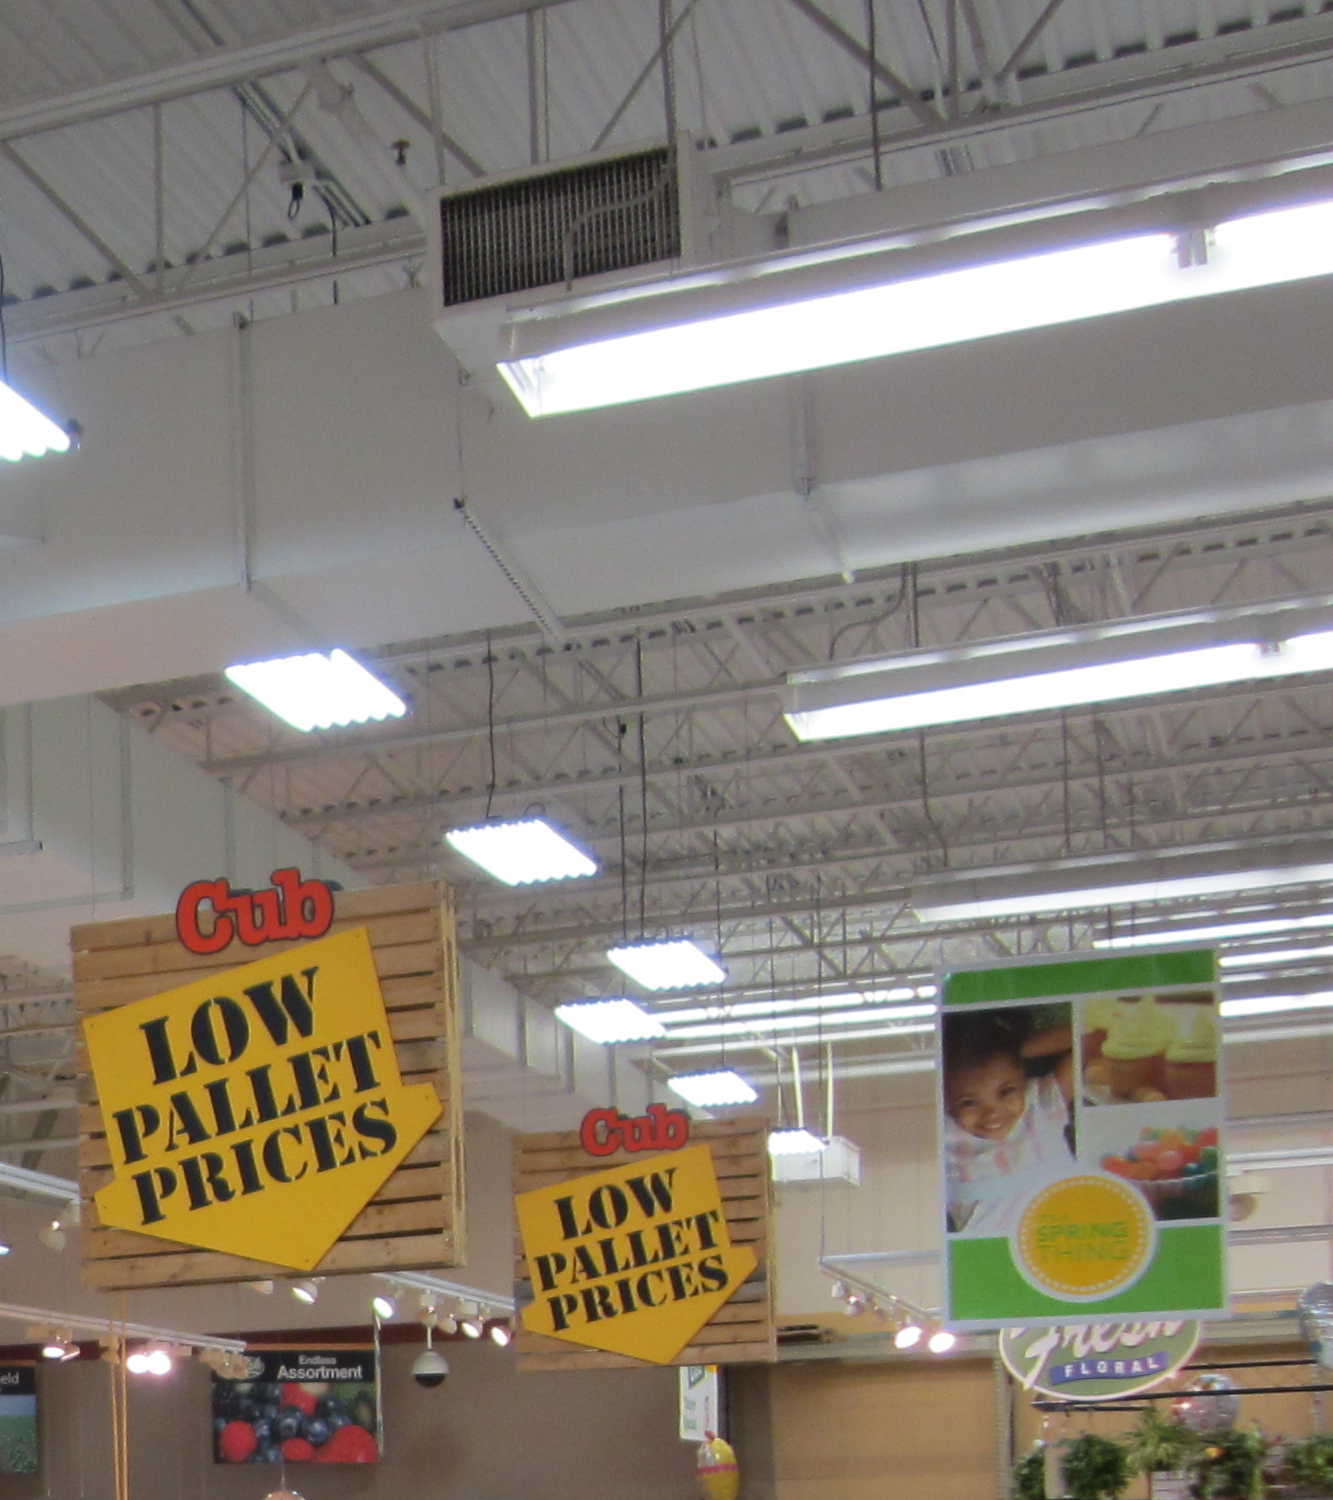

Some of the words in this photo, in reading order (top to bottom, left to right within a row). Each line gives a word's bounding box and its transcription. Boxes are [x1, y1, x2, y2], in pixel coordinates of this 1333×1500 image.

[176, 868, 334, 954] Cub
[139, 966, 319, 1085] LOW
[112, 1030, 382, 1165] PALLET
[580, 1103, 689, 1157] Cub
[132, 1098, 398, 1226] PRICES
[554, 1167, 678, 1240] LOW
[1037, 1220, 1129, 1243] SPRING
[534, 1209, 720, 1292] PALLET
[547, 1254, 729, 1331] PRICES
[276, 1365, 363, 1379] Assortment
[298, 1355, 337, 1365] Endless
[1064, 1356, 1161, 1378] FLORAL
